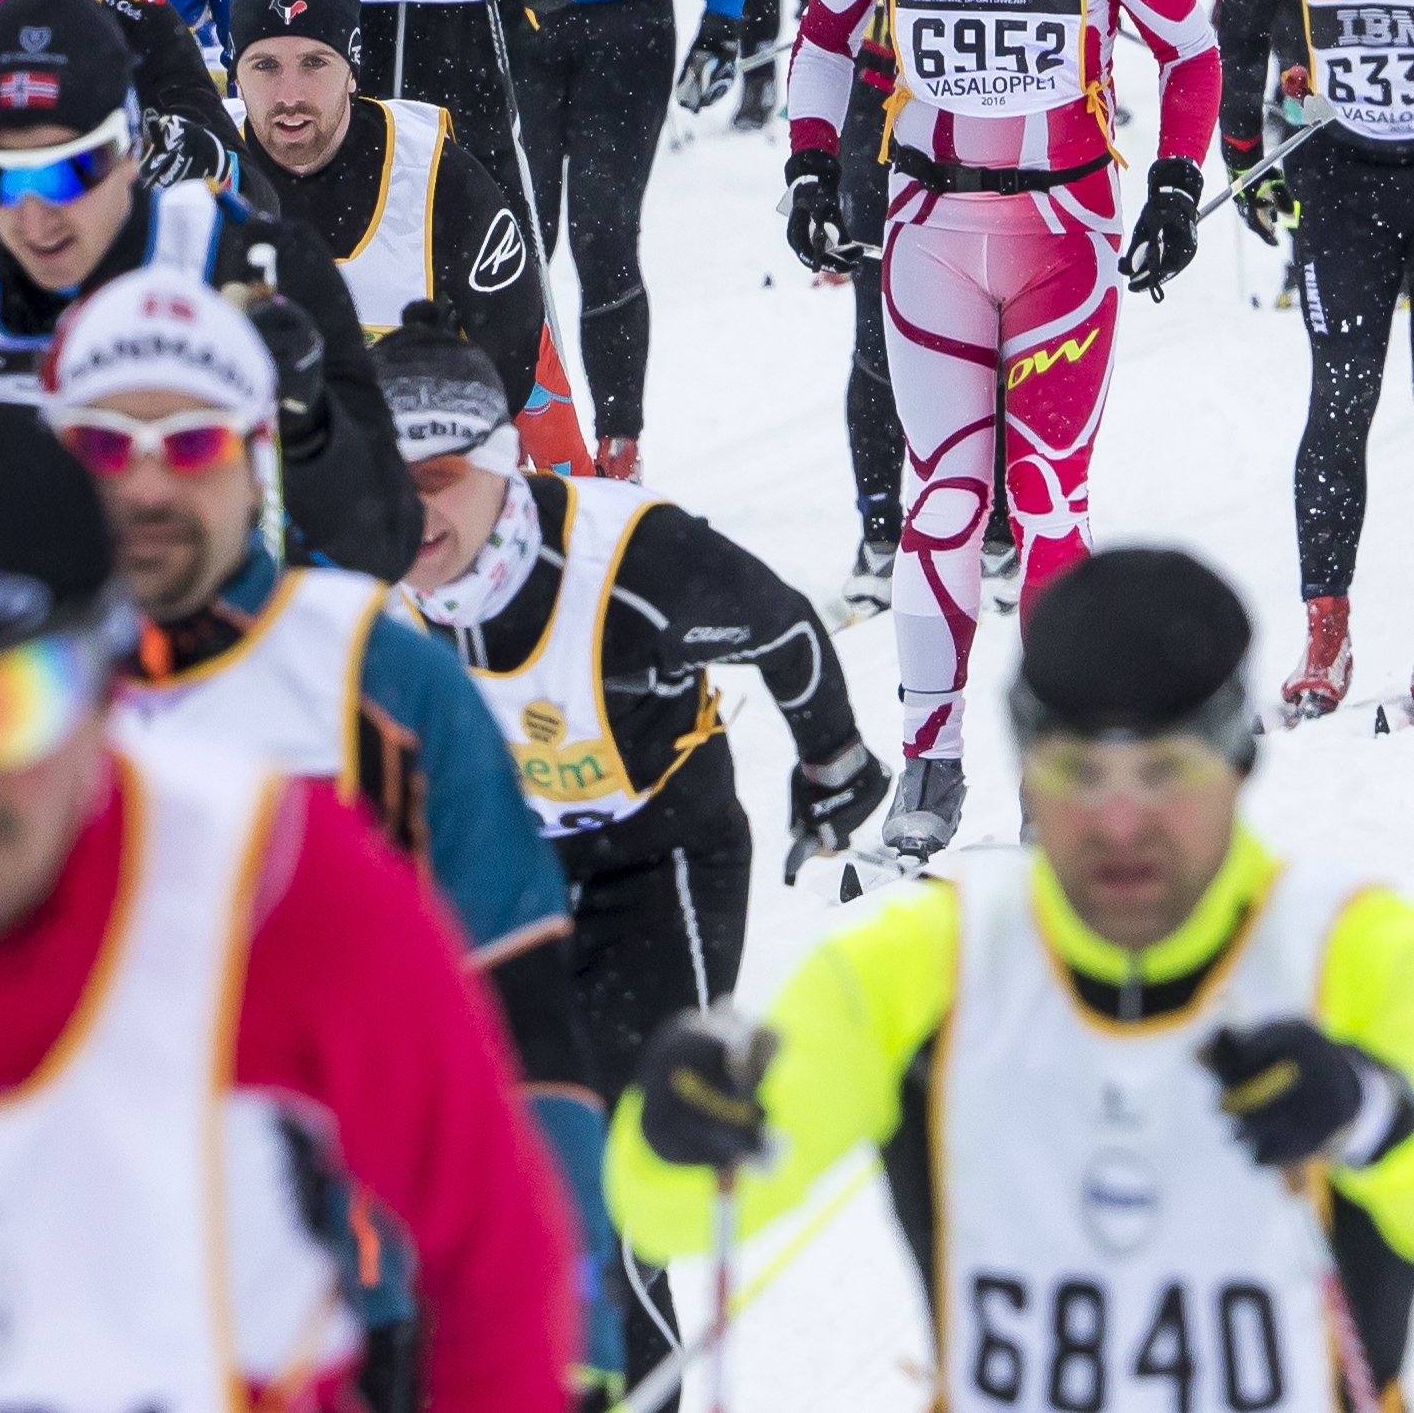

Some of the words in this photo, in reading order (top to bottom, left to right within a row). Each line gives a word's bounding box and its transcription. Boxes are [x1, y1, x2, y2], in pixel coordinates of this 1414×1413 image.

[912, 17, 1066, 79] 6952
[925, 75, 1057, 98] VASALOPPET
[981, 96, 1006, 107] 2016
[970, 1274, 1286, 1413] 6840
